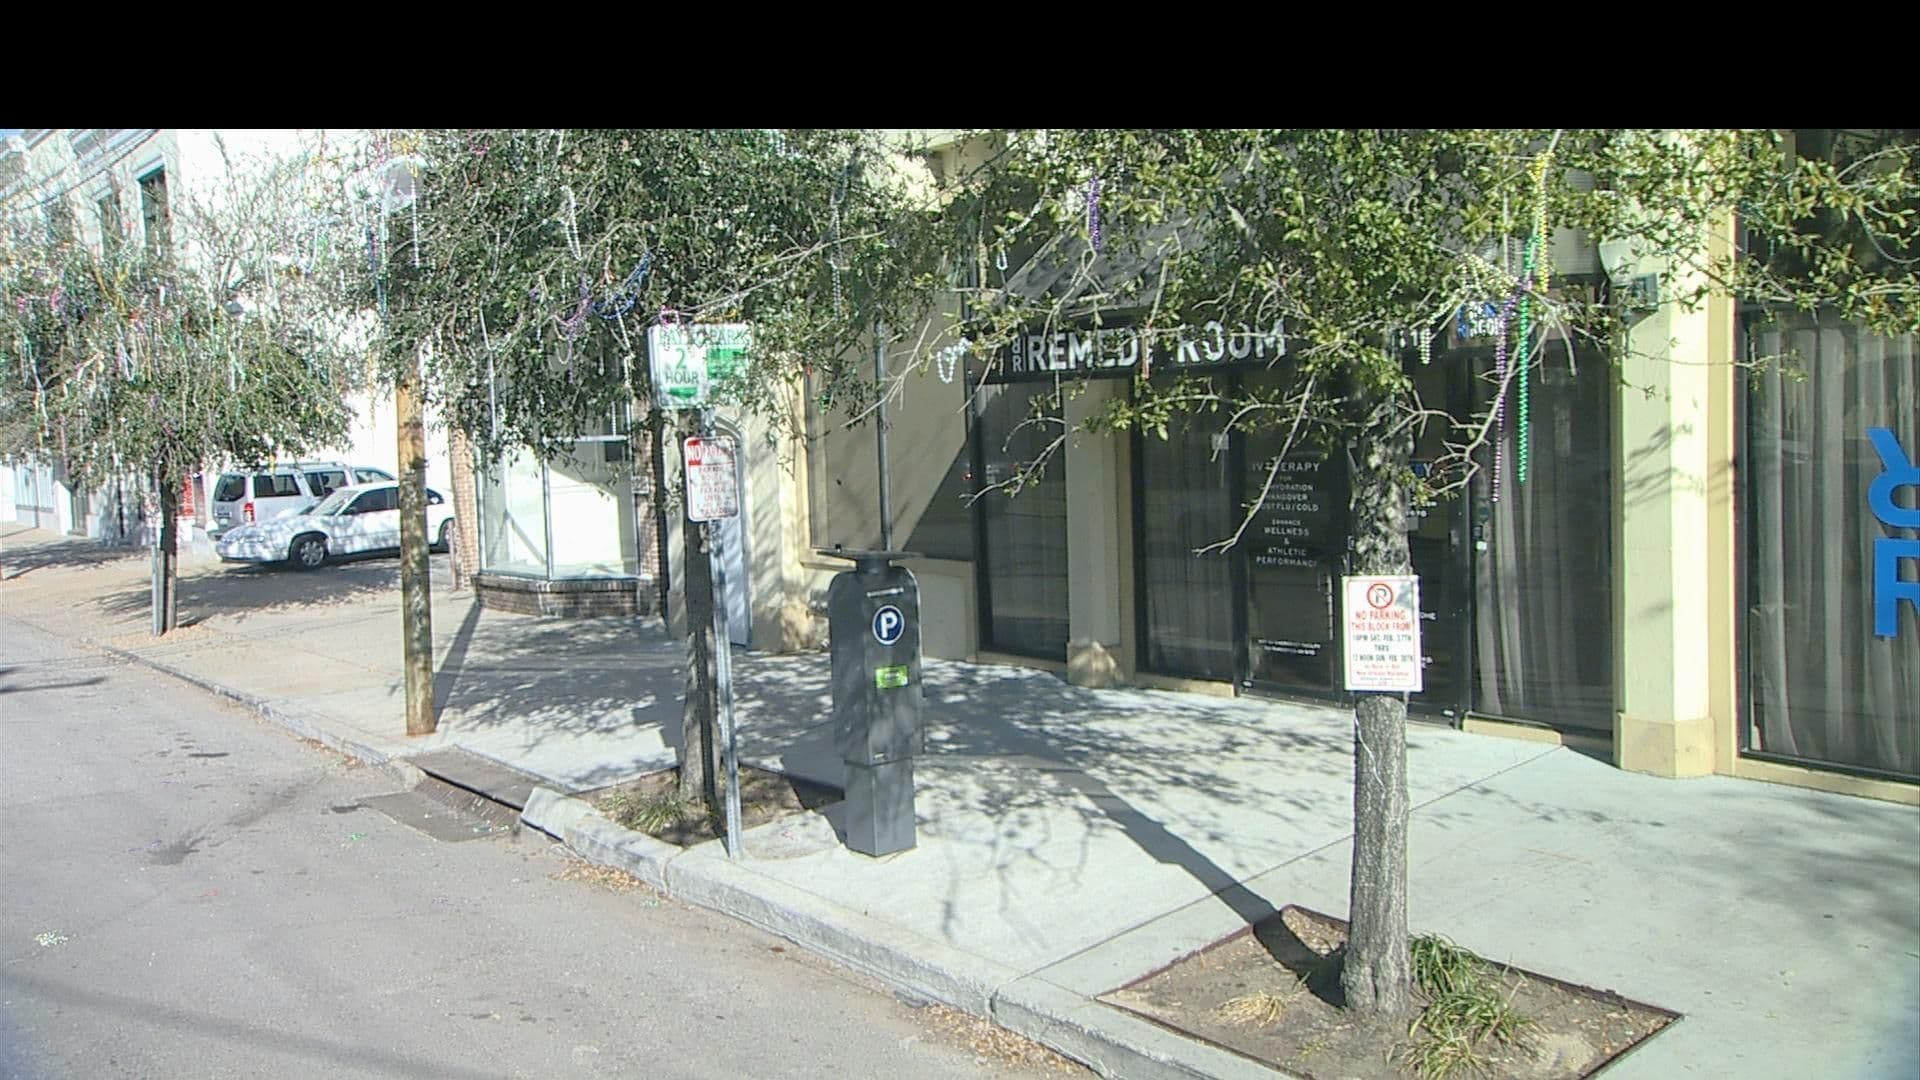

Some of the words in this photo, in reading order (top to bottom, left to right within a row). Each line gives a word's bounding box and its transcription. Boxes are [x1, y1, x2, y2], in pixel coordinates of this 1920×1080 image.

[1028, 327, 1154, 371] REMED
[1177, 319, 1287, 362] ROOM
[674, 348, 687, 370] 2
[665, 370, 700, 384] HOUR
[687, 446, 702, 463] NO
[1252, 463, 1264, 473] IV
[1264, 527, 1309, 537] WELLNESS
[1268, 547, 1307, 556] ATHLETIC
[1355, 609, 1367, 621] NO
[1370, 609, 1406, 621] PARKING
[881, 611, 898, 639] P
[1352, 621, 1366, 631] THIS
[1368, 622, 1389, 631] BLOCK
[1392, 622, 1411, 632] FROM
